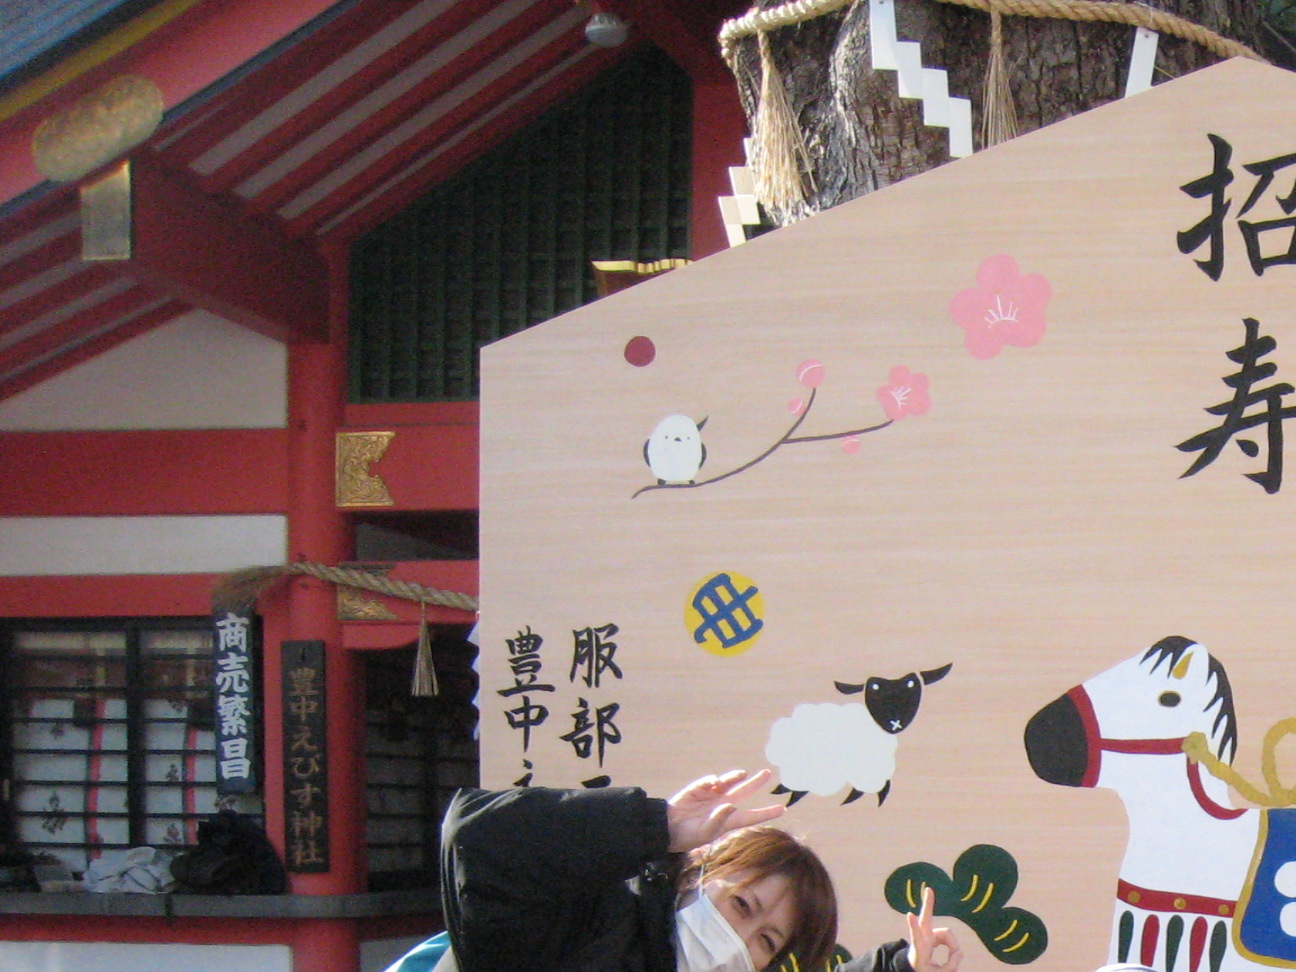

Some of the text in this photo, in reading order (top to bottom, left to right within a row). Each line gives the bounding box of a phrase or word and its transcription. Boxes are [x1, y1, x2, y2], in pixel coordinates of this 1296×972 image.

[215, 611, 252, 780] 商売繁昌
[289, 666, 324, 866] 豊中えびす神社
[559, 622, 623, 788] 服部
